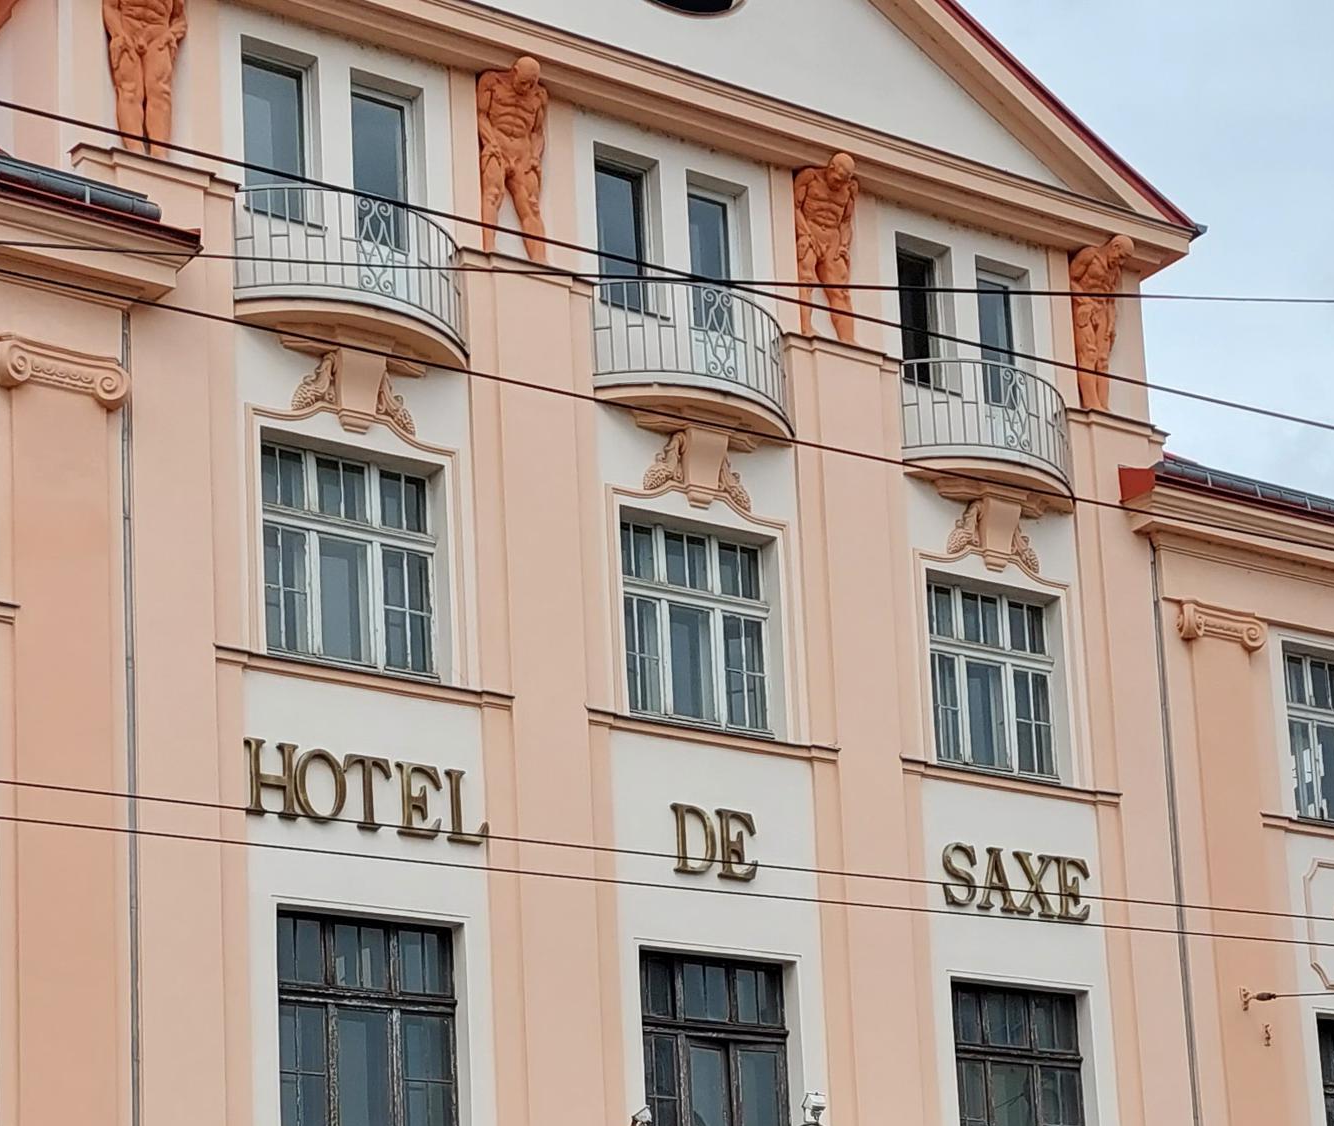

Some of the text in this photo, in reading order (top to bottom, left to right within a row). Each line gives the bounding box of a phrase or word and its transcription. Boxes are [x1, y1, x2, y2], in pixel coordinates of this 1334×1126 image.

[243, 736, 1090, 922] HOTEL DE SAXE
